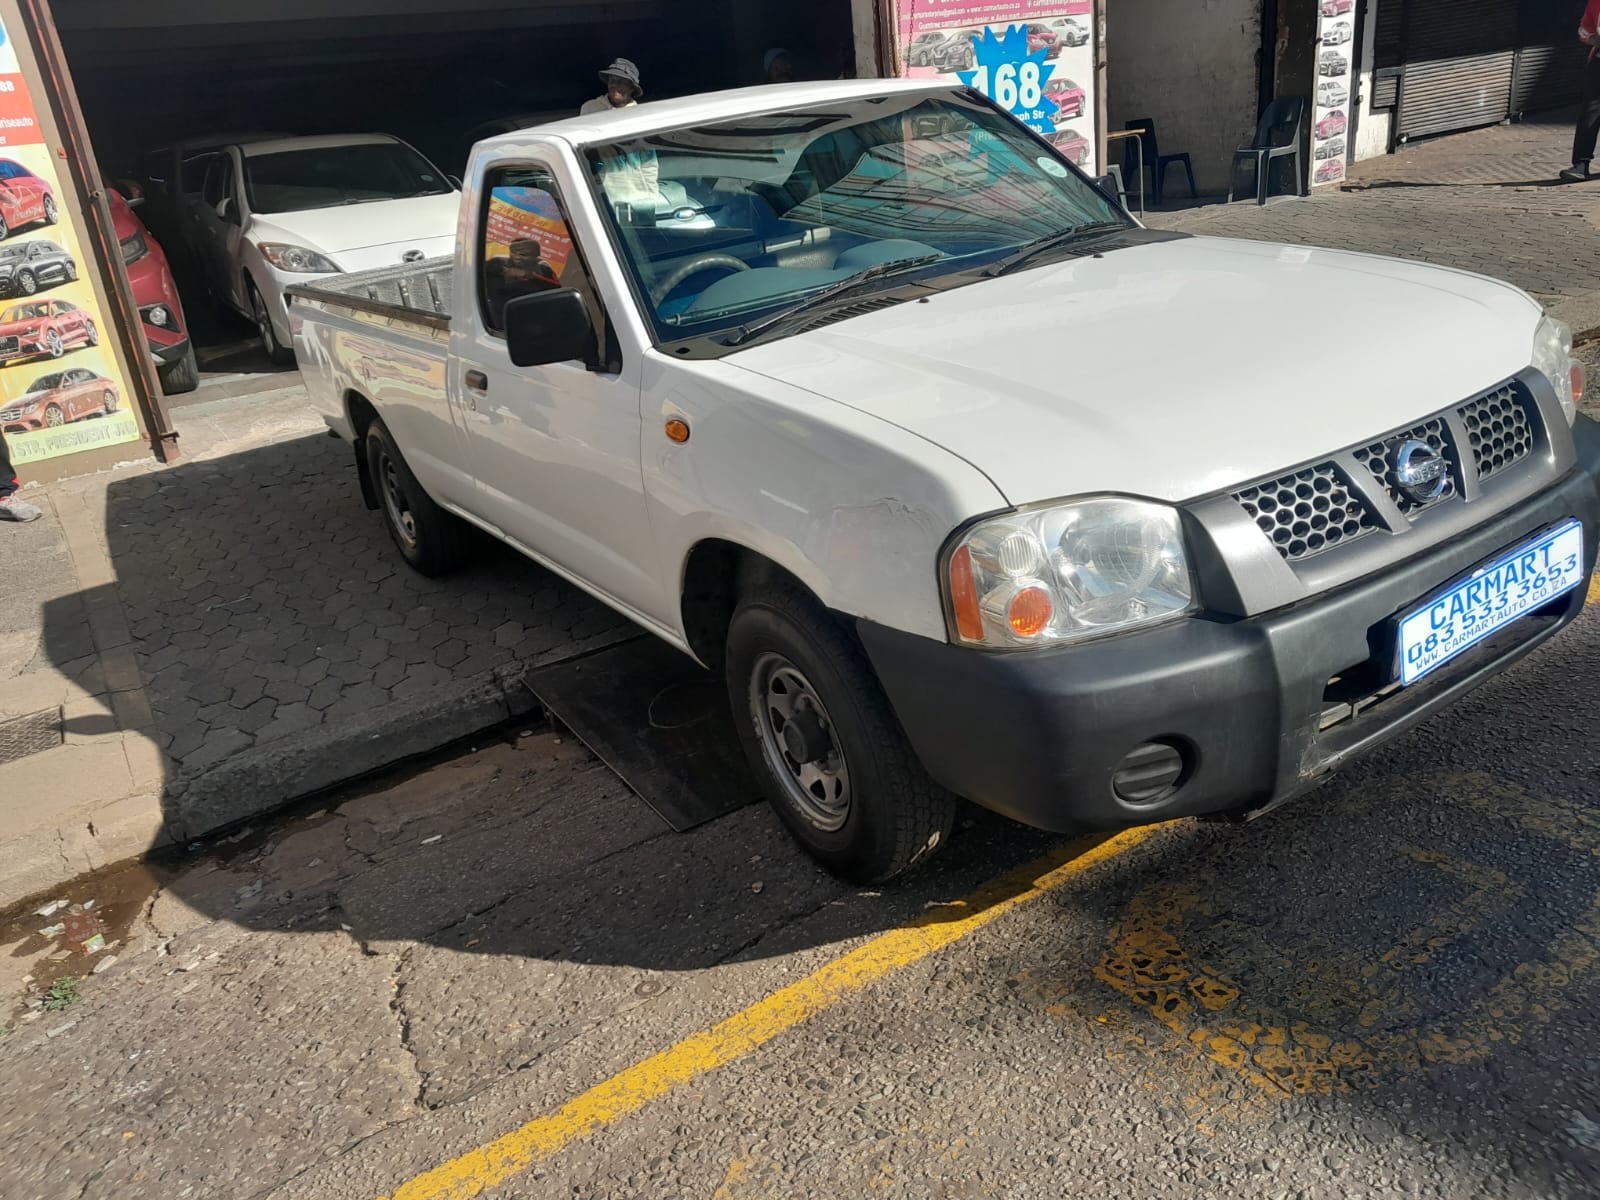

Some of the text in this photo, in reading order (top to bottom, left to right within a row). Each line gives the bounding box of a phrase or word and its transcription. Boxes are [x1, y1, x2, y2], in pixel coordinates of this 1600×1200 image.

[971, 61, 1041, 111] 168
[1408, 553, 1577, 664] 083 533 3653
[1430, 542, 1554, 630] CARMART
